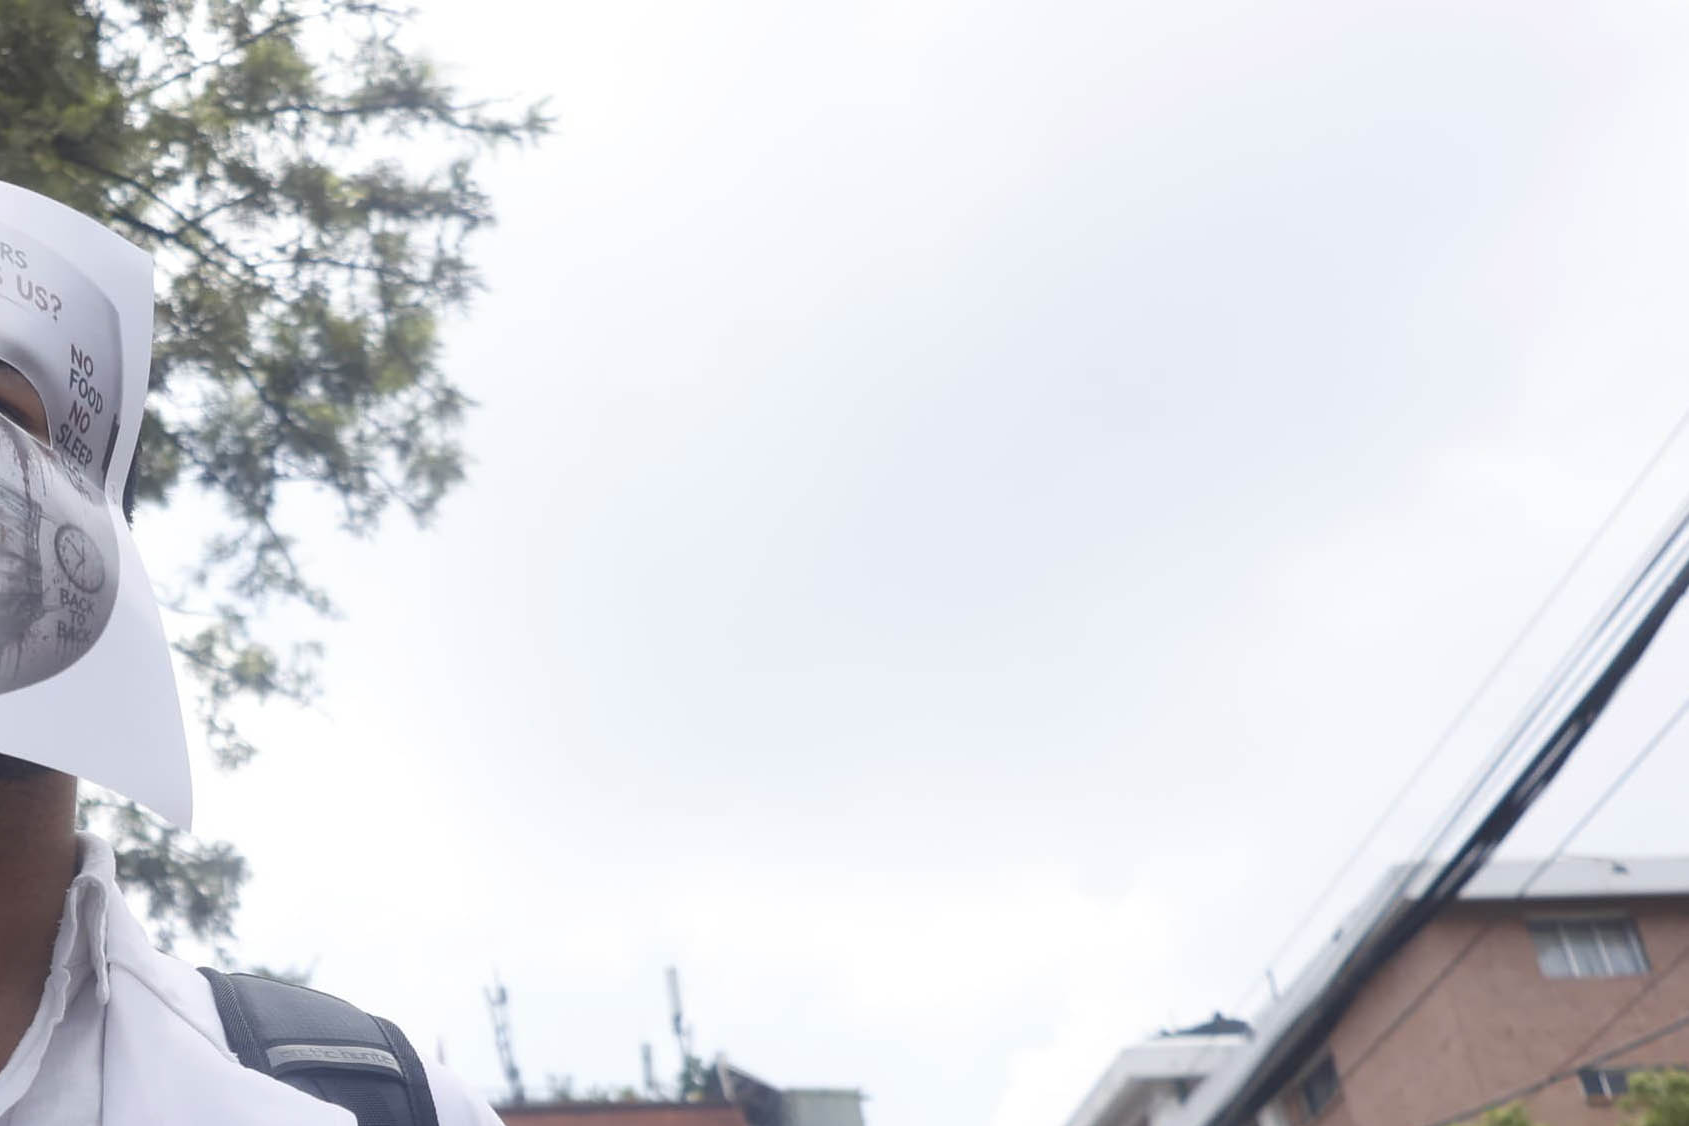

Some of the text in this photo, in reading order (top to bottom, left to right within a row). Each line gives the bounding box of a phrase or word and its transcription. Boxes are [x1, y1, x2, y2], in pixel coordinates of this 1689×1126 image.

[16, 275, 64, 321] US?
[70, 343, 93, 377] NO
[69, 366, 103, 415] FOOD
[68, 399, 91, 434] NO
[56, 423, 93, 468] SLEEP
[60, 588, 95, 616] BACK
[69, 609, 86, 626] TO
